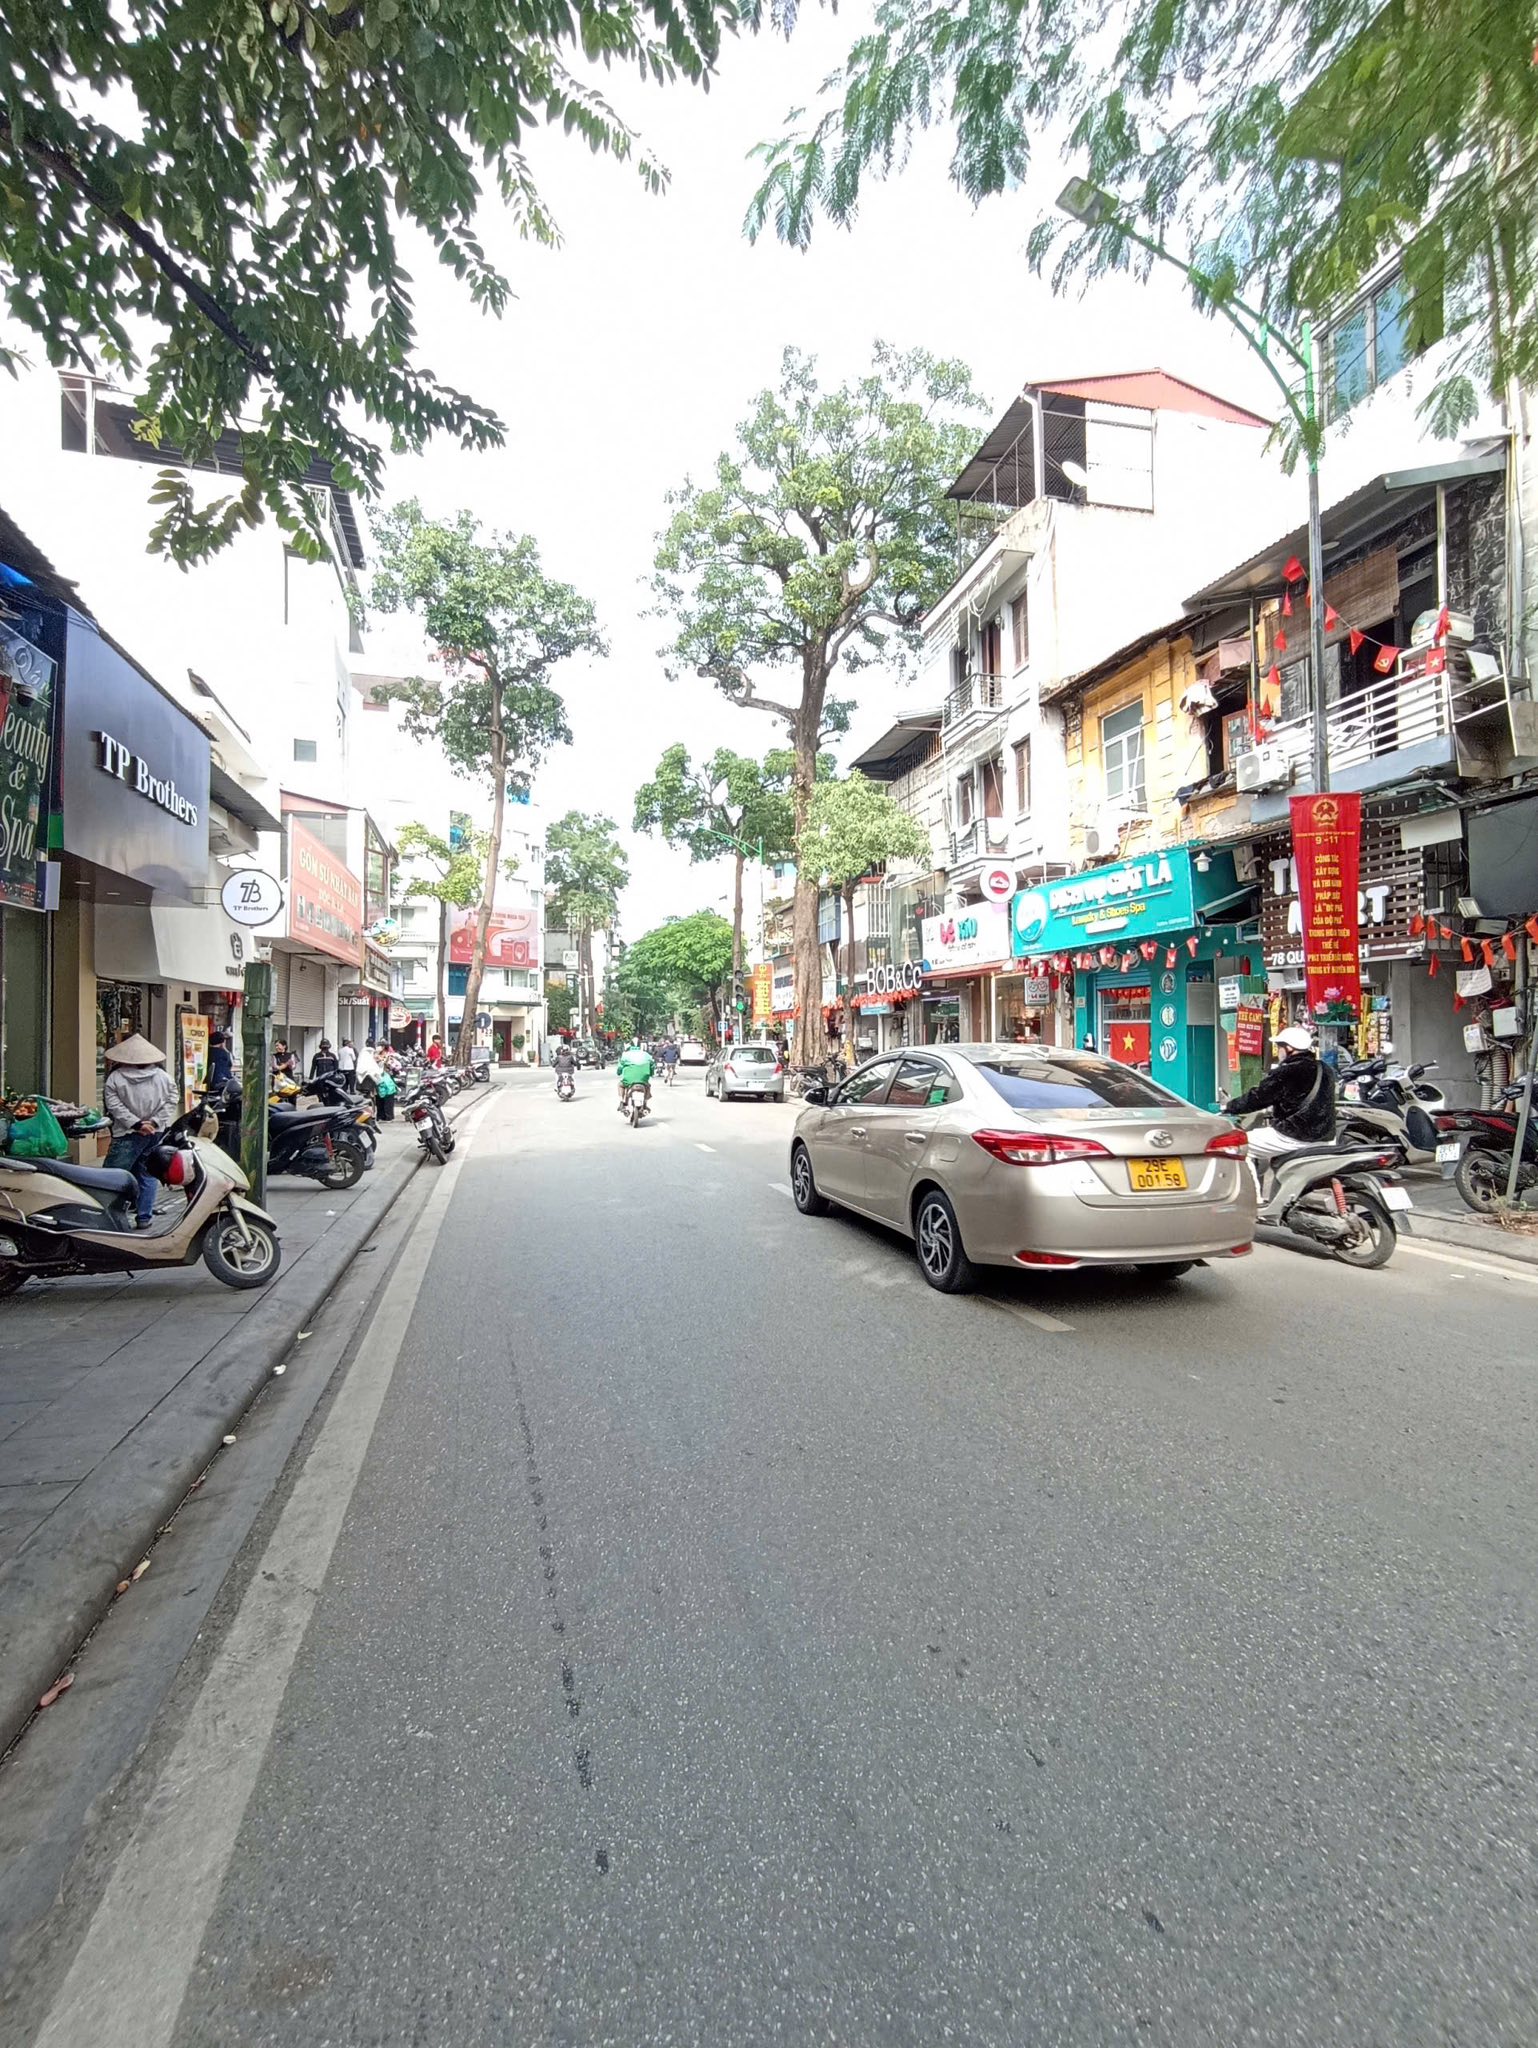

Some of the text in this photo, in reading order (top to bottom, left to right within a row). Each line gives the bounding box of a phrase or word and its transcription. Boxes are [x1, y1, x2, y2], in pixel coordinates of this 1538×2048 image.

[0, 702, 51, 784] eauty
[8, 760, 28, 790] &
[101, 731, 199, 828] TP Brothers
[0, 794, 36, 872] Spa
[1145, 852, 1173, 887] LÀ
[1106, 904, 1129, 919] Shoes
[1130, 900, 1146, 915] Spa
[1272, 953, 1285, 965] 78
[1143, 1159, 1168, 1173] 29E
